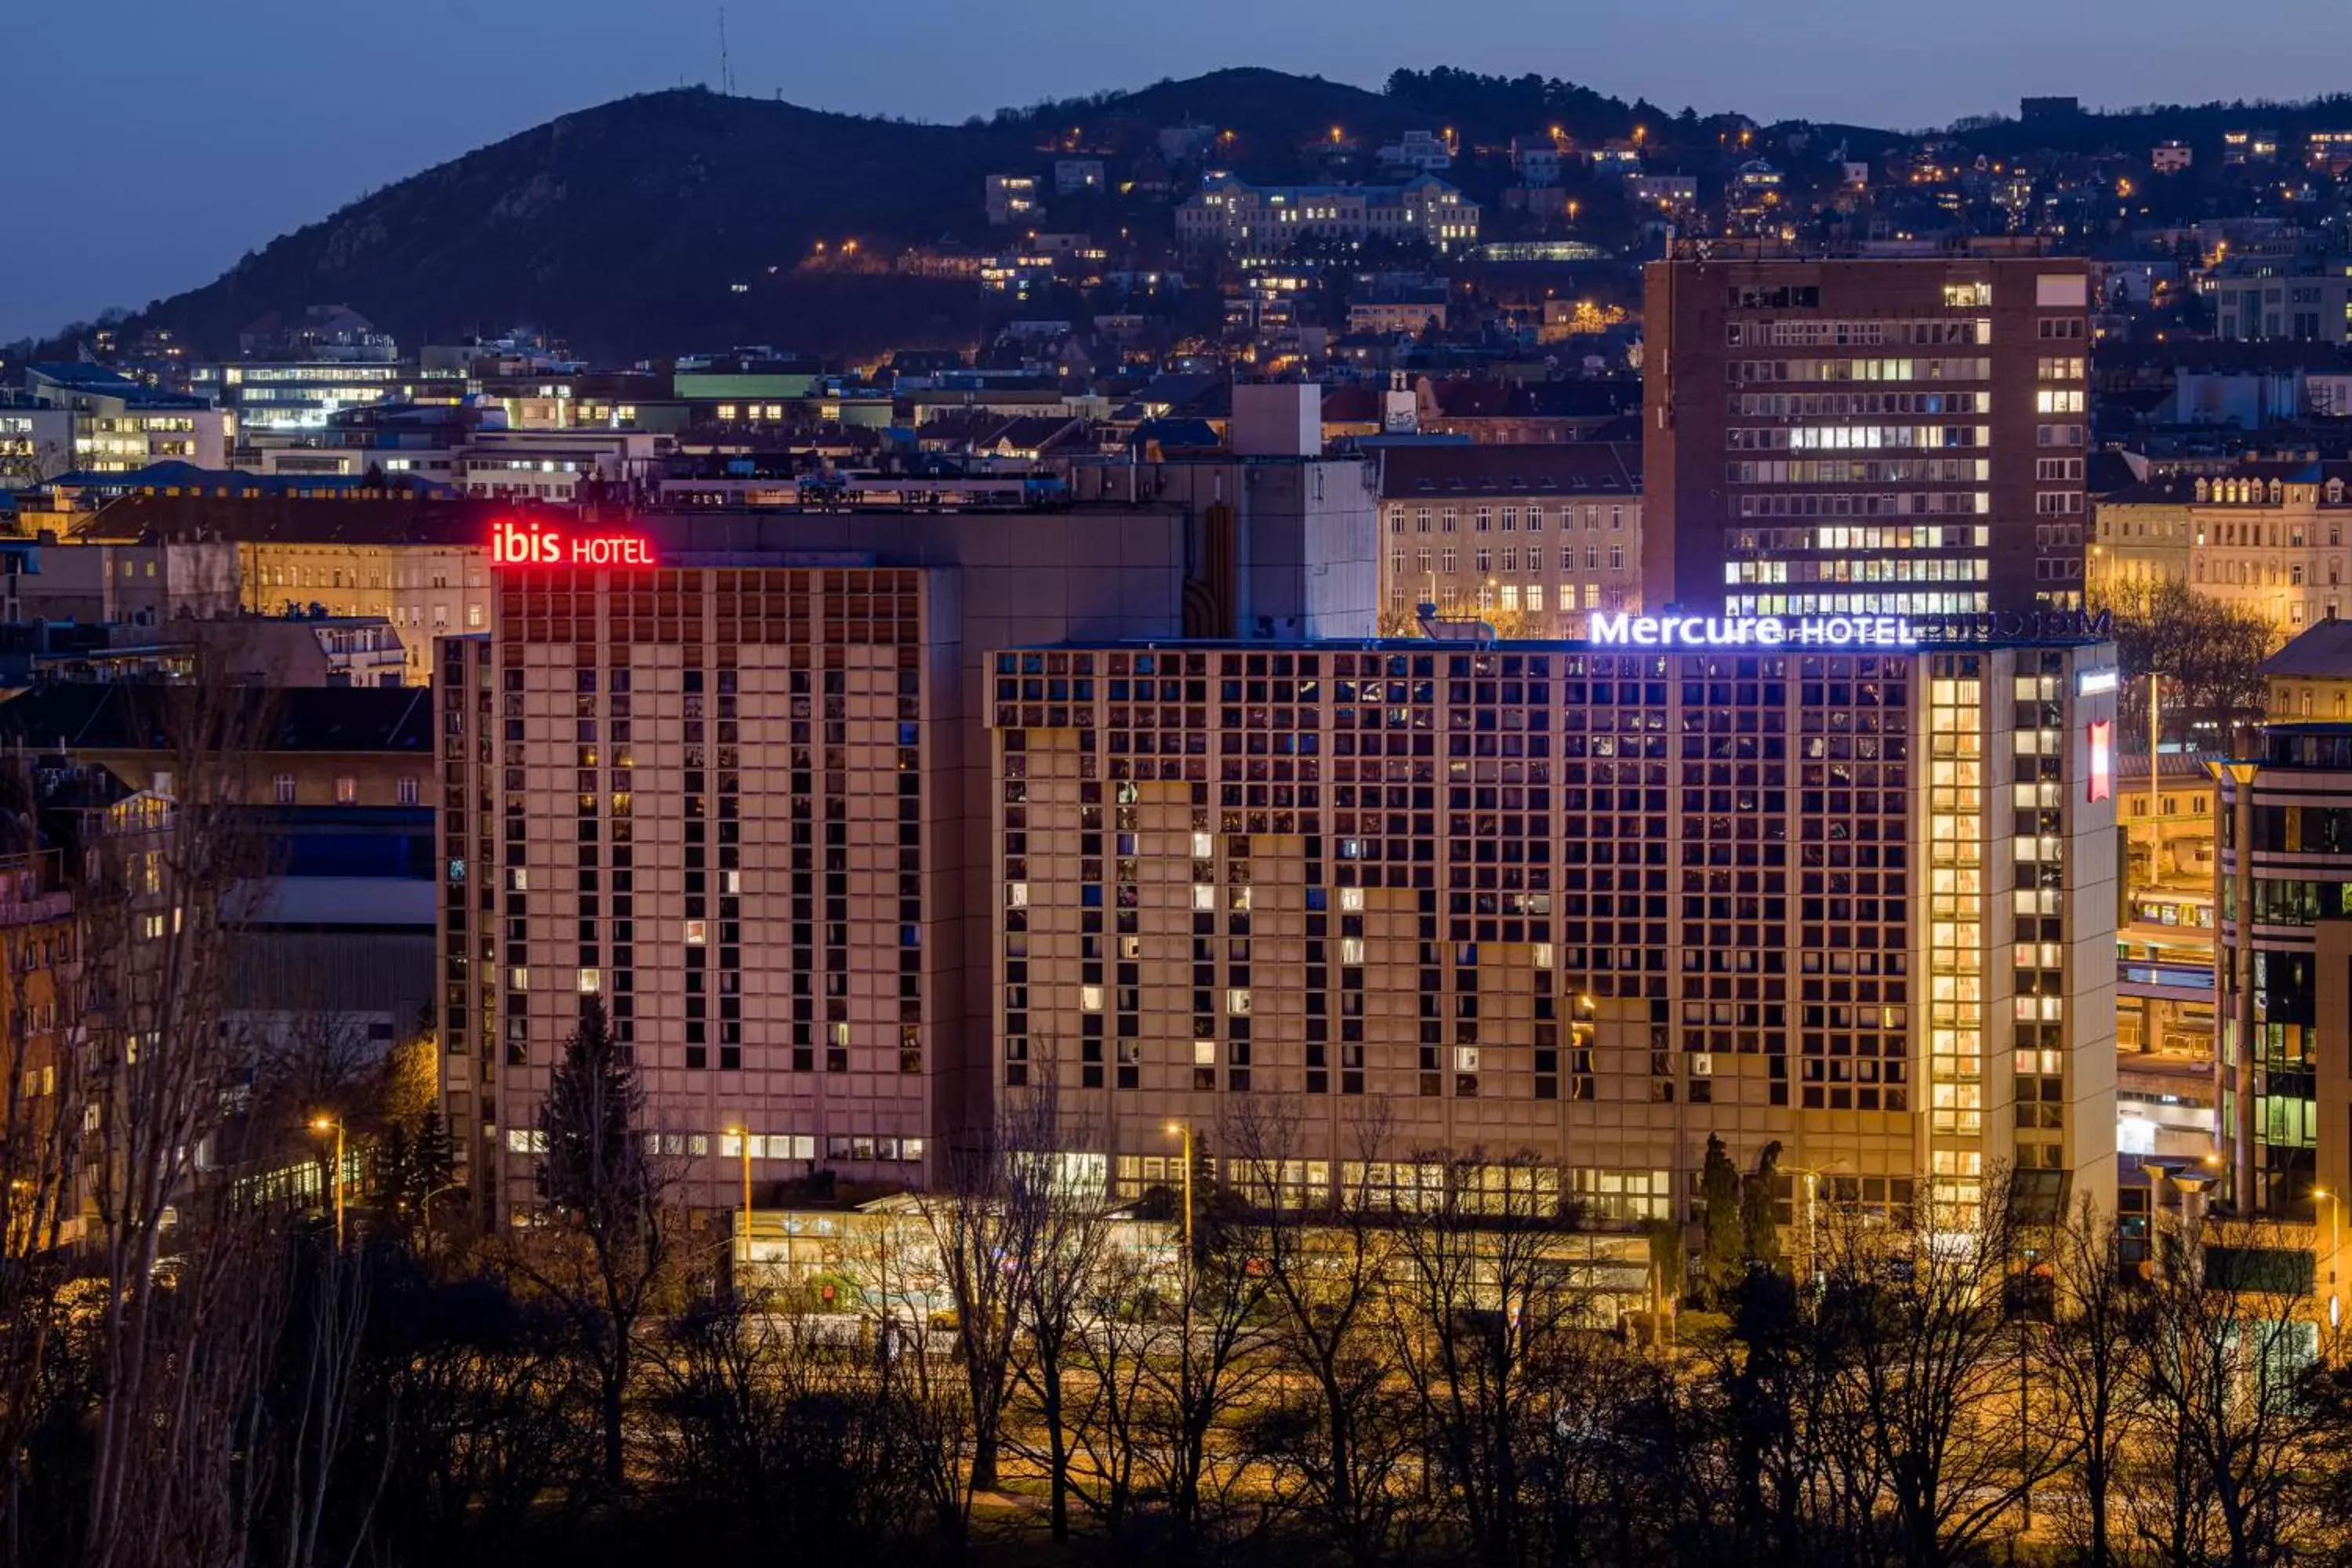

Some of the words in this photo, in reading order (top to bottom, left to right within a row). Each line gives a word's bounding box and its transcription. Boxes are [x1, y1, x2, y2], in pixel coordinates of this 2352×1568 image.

[493, 523, 561, 562] ibis
[572, 539, 654, 563] HOTEL
[1591, 612, 1782, 644] Mercure
[1802, 617, 1917, 644] HOTEL
